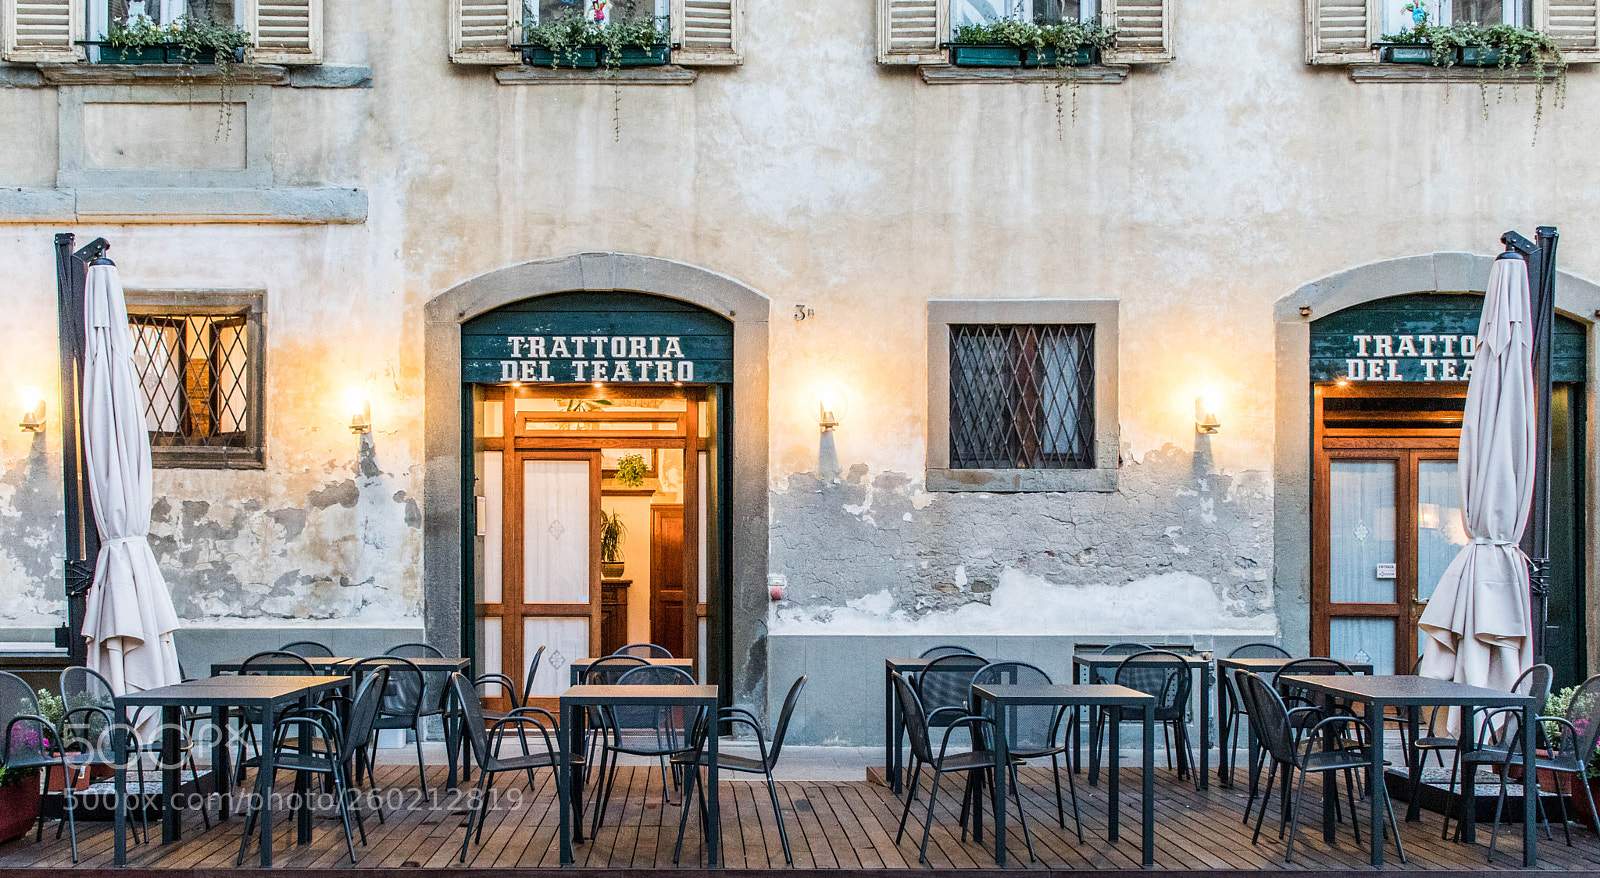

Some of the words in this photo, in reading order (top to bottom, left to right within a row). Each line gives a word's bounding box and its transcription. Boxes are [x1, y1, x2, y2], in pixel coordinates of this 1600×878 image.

[507, 336, 684, 358] TRATTORIA
[500, 360, 554, 382] DEL
[571, 360, 694, 382] TEATRO
[1346, 359, 1403, 381] DEL
